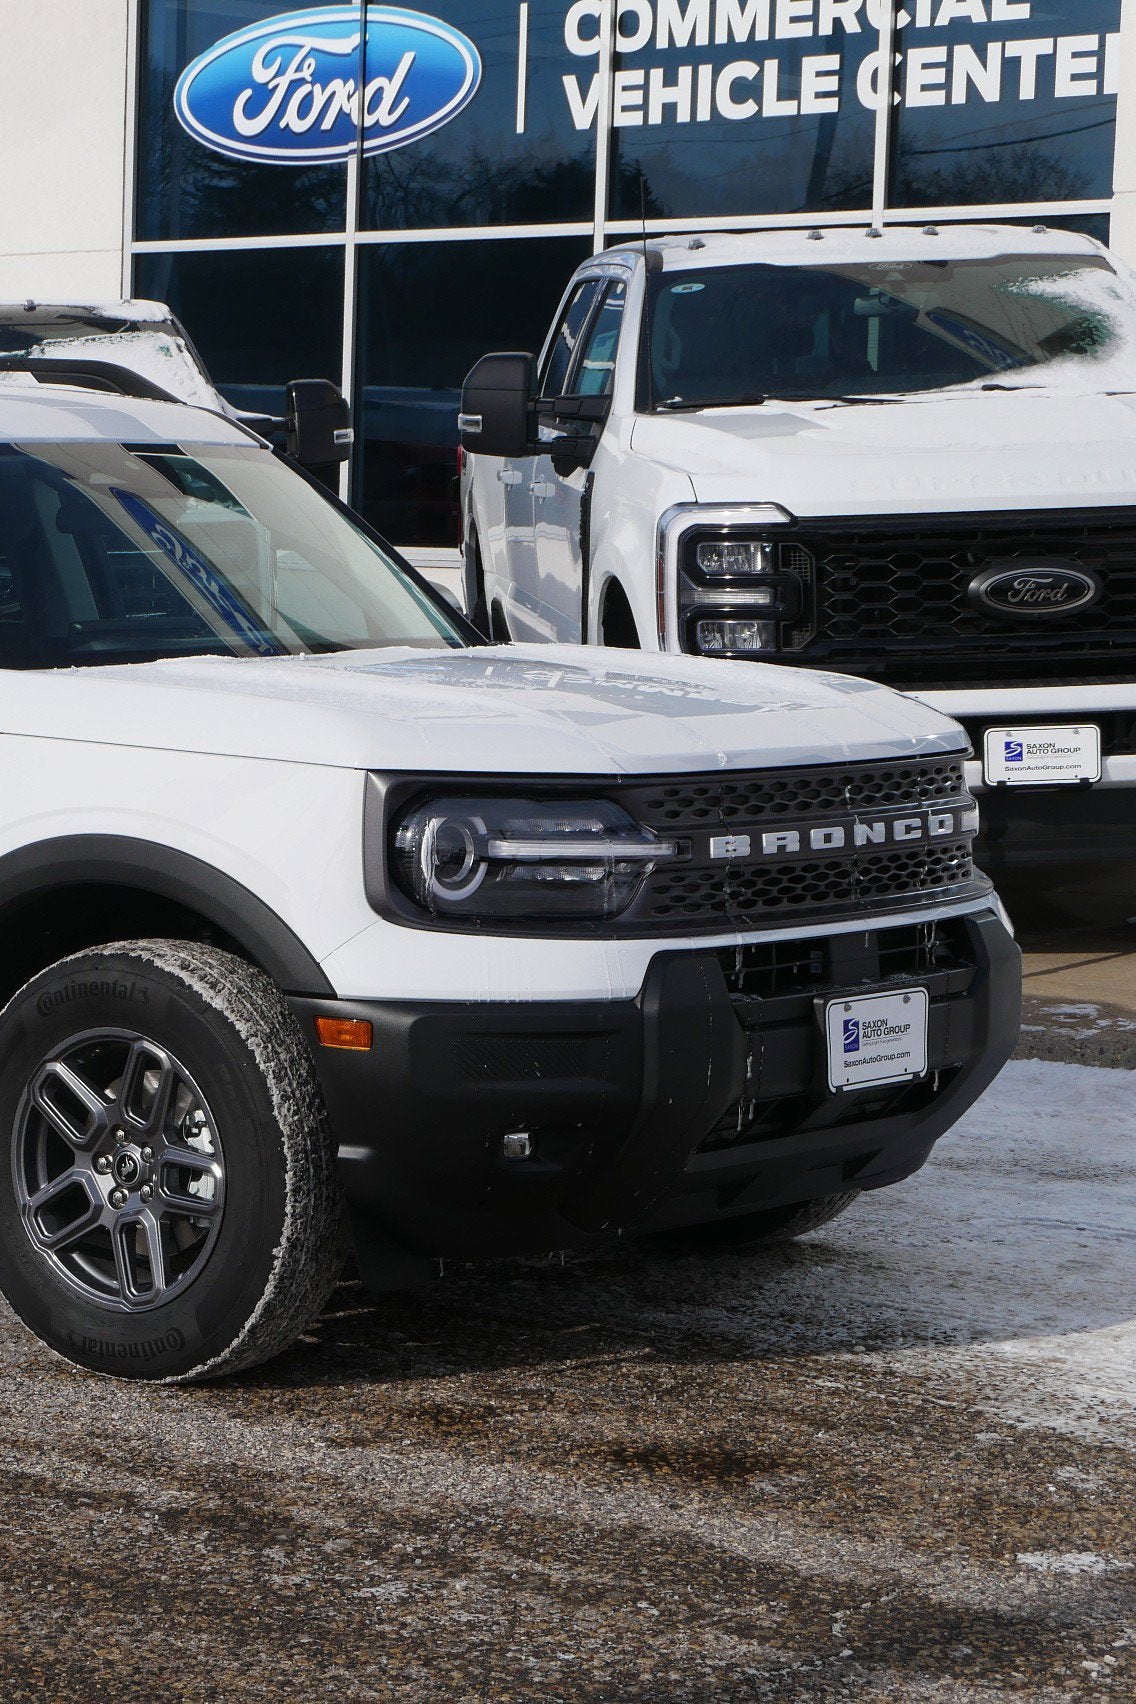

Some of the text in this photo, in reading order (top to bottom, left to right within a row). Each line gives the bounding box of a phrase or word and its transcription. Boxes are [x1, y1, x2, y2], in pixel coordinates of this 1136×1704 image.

[233, 33, 416, 136] Ford
[562, 54, 841, 131] VEHICLE
[1007, 577, 1069, 603] Ford
[1026, 742, 1056, 750] SAXON
[1004, 764, 1082, 772] SaxonAutoGroup.com
[709, 813, 954, 859] BRONCO
[36, 979, 137, 1017] Continental
[861, 1018, 888, 1031] SAXON
[861, 1023, 911, 1040] AUTO GROUP
[843, 1050, 911, 1068] SaxonAutoGroup.com
[80, 1326, 186, 1361] Continental
